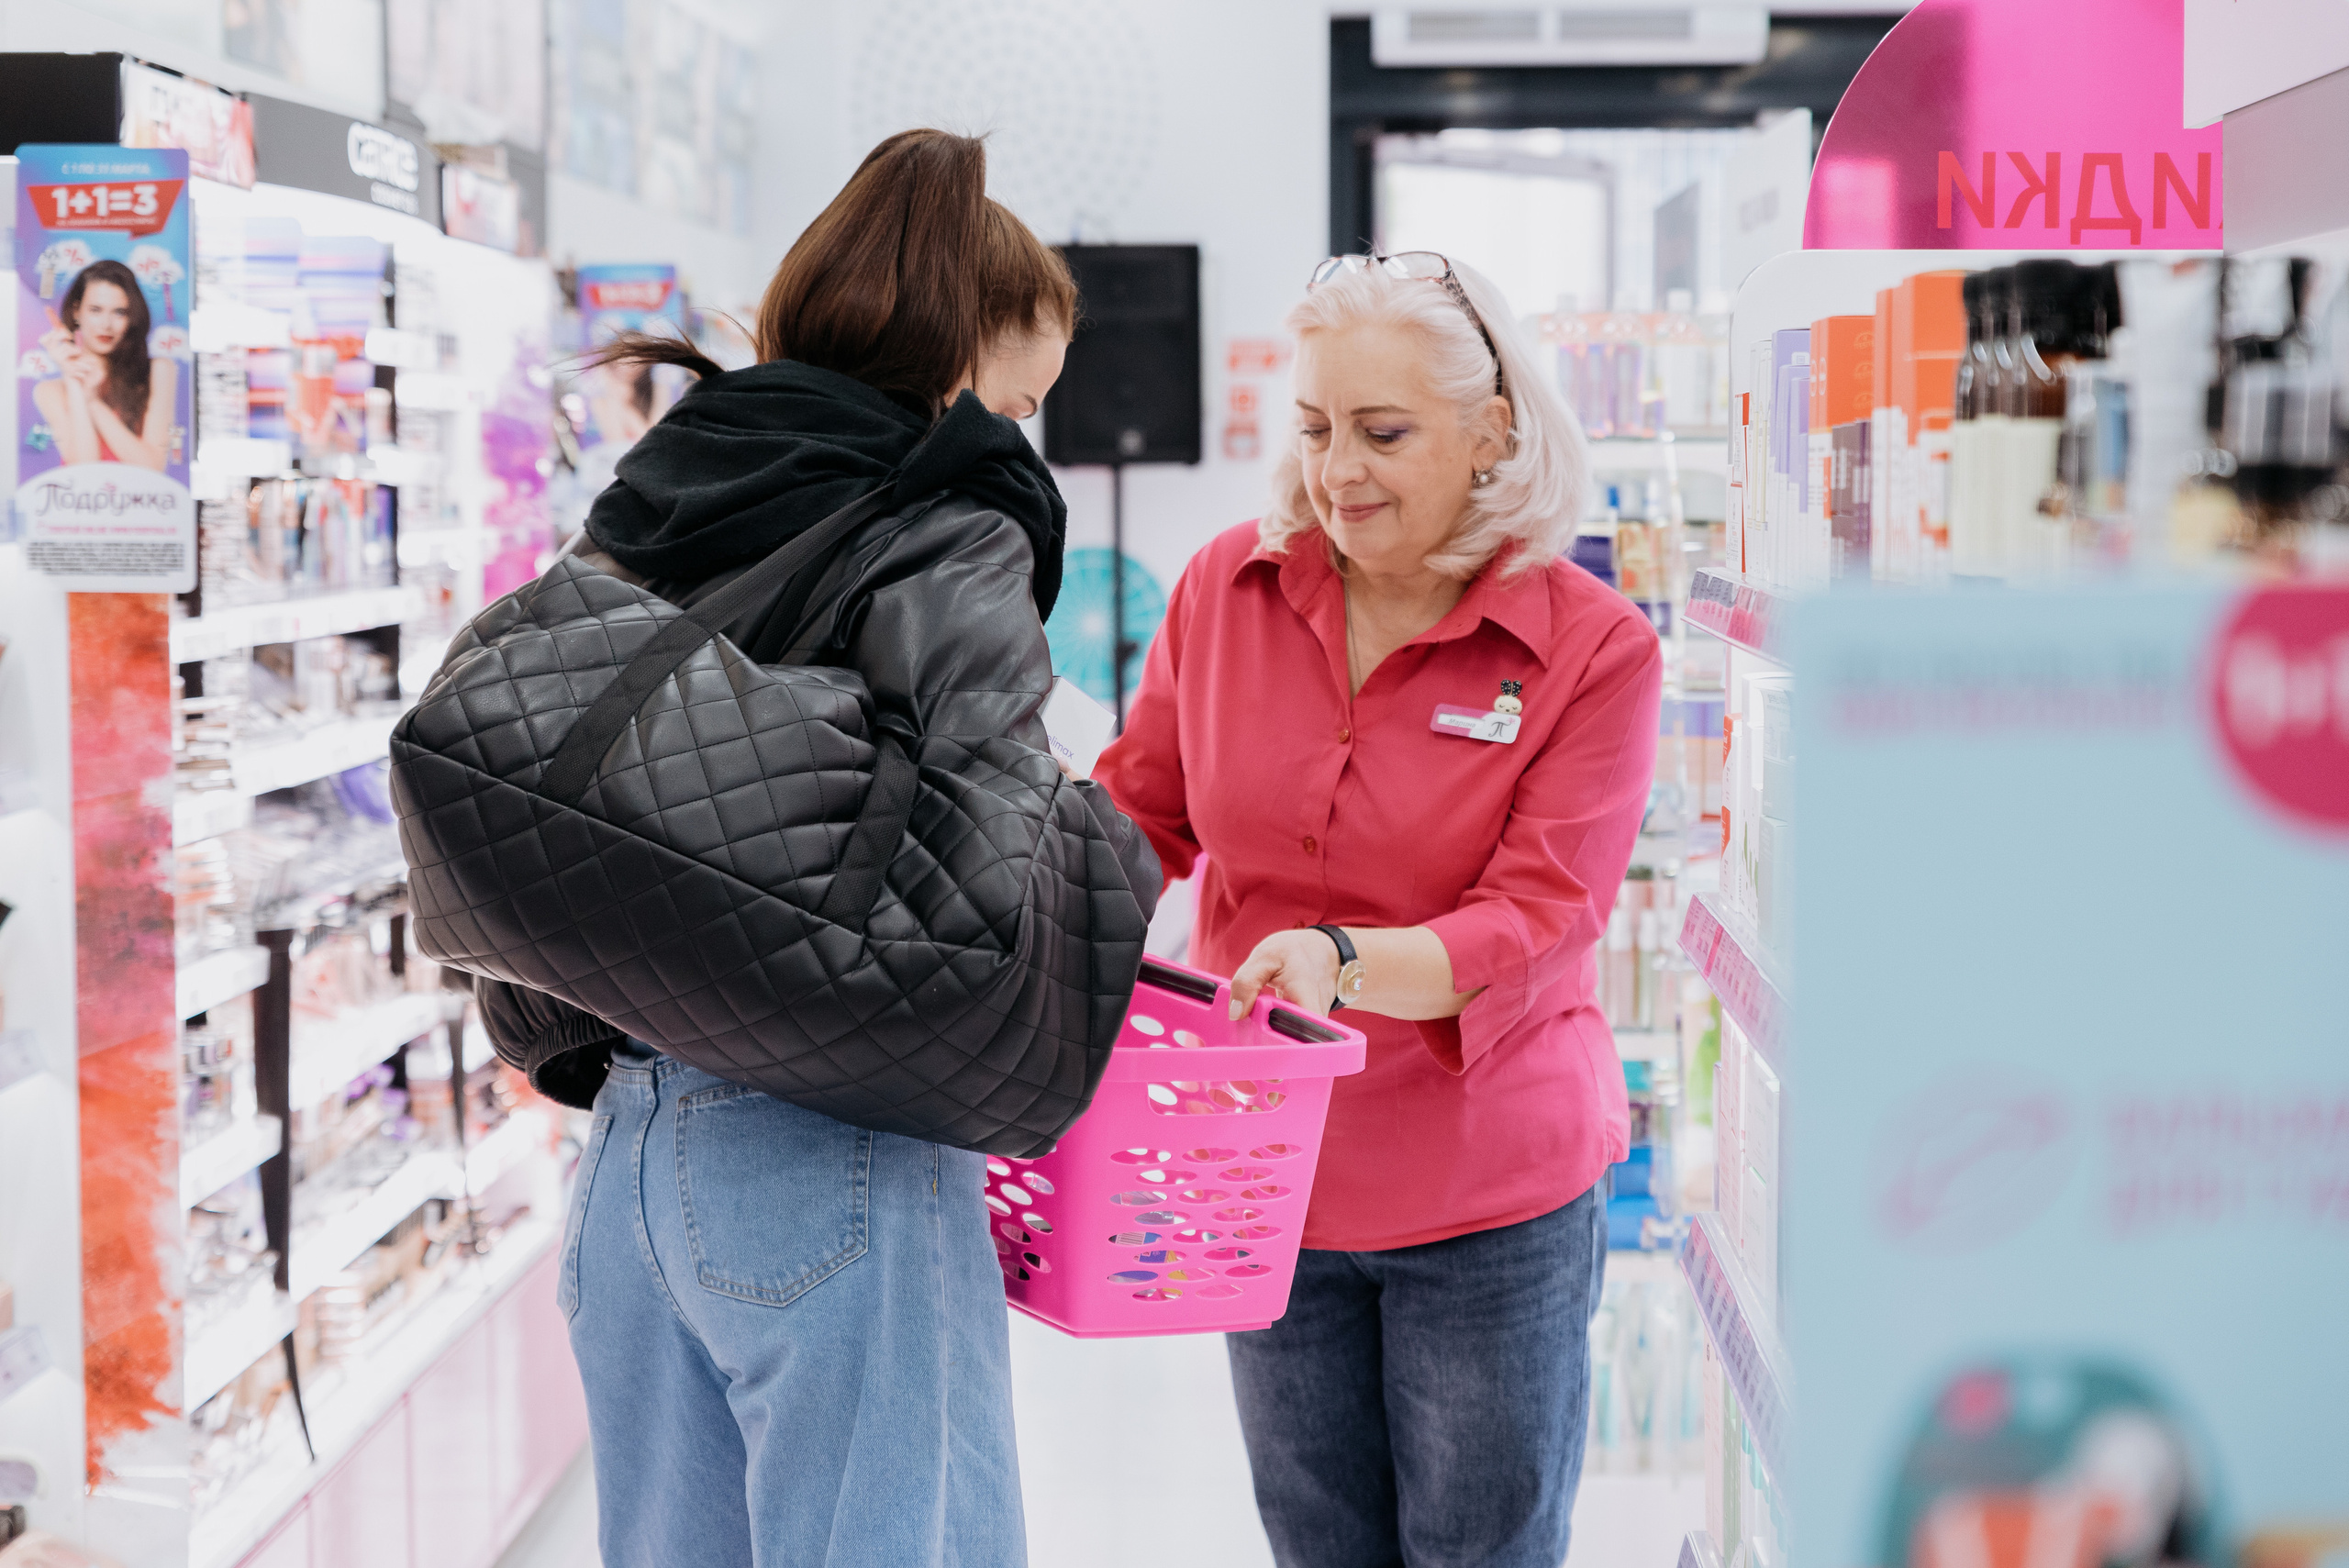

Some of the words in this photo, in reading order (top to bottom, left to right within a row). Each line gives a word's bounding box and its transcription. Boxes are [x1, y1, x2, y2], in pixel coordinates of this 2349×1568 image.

[51, 183, 159, 218] 1+1=3
[35, 480, 177, 517] Подружка
[1046, 734, 1074, 760] elimax
